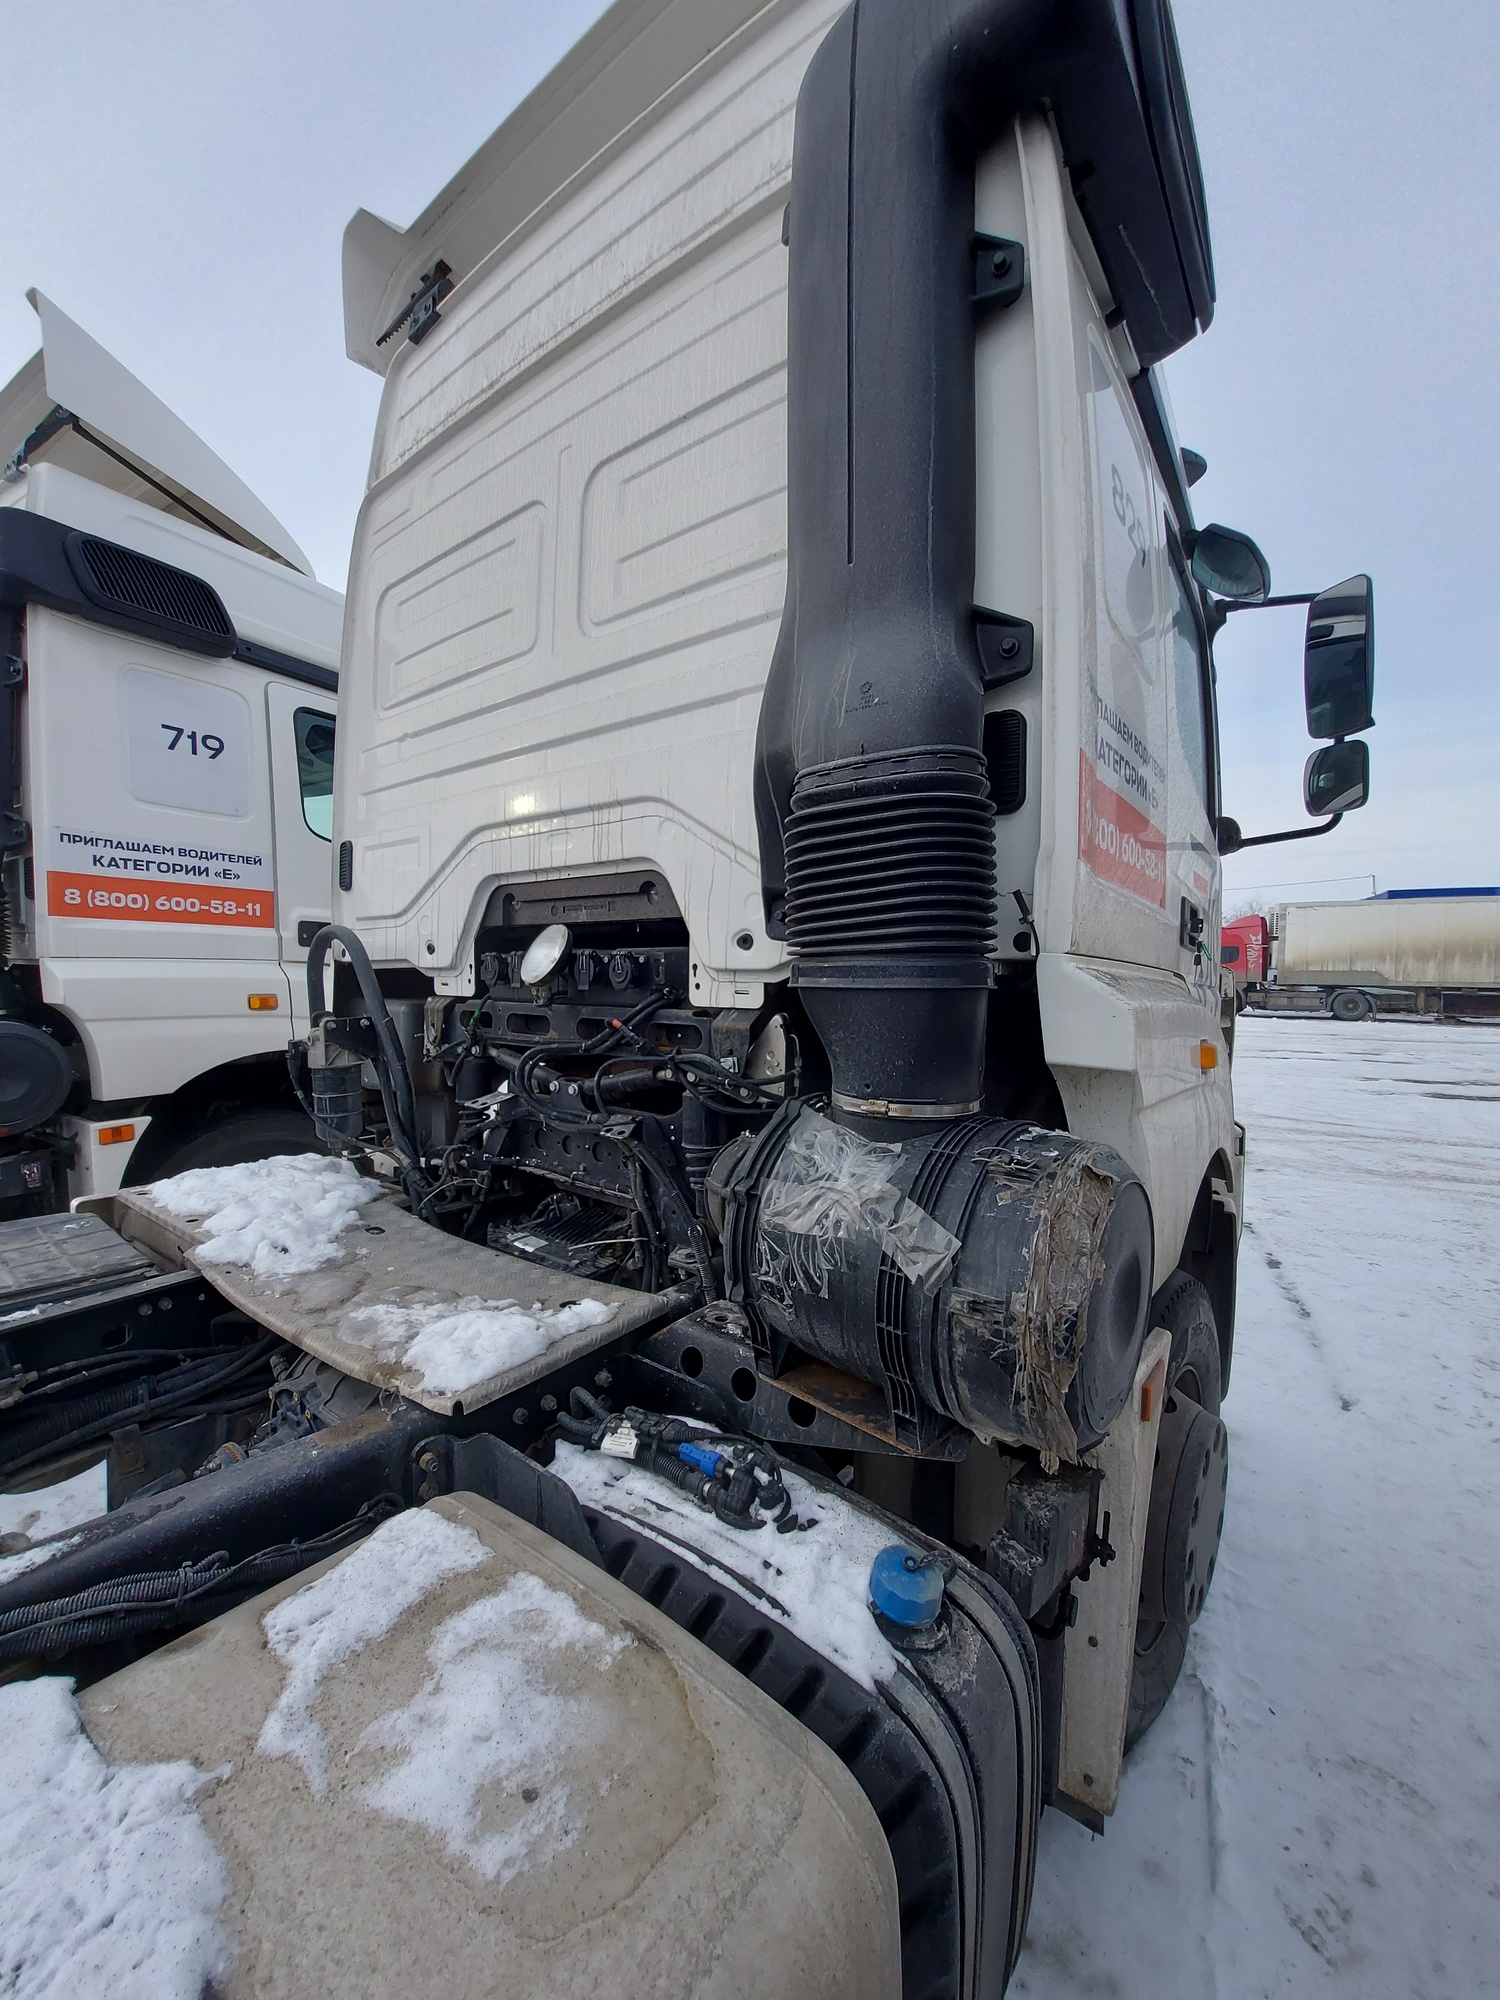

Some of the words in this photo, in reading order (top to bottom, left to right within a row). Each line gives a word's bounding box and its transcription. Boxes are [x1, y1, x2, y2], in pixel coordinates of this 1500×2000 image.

[1110, 463, 1146, 568] 829
[161, 723, 225, 760] 719
[1096, 735, 1148, 803] АТЕГОРИИ
[59, 832, 175, 856] ПРИГЛАШАЕМ
[177, 846, 263, 867] ВОДИТЕЛЕЙ
[92, 854, 210, 878] КАТЕГОРИИ
[214, 868, 241, 881] «Е»
[64, 888, 81, 905] 8
[87, 889, 149, 911] (800)
[155, 895, 261, 917] 600-58-11
